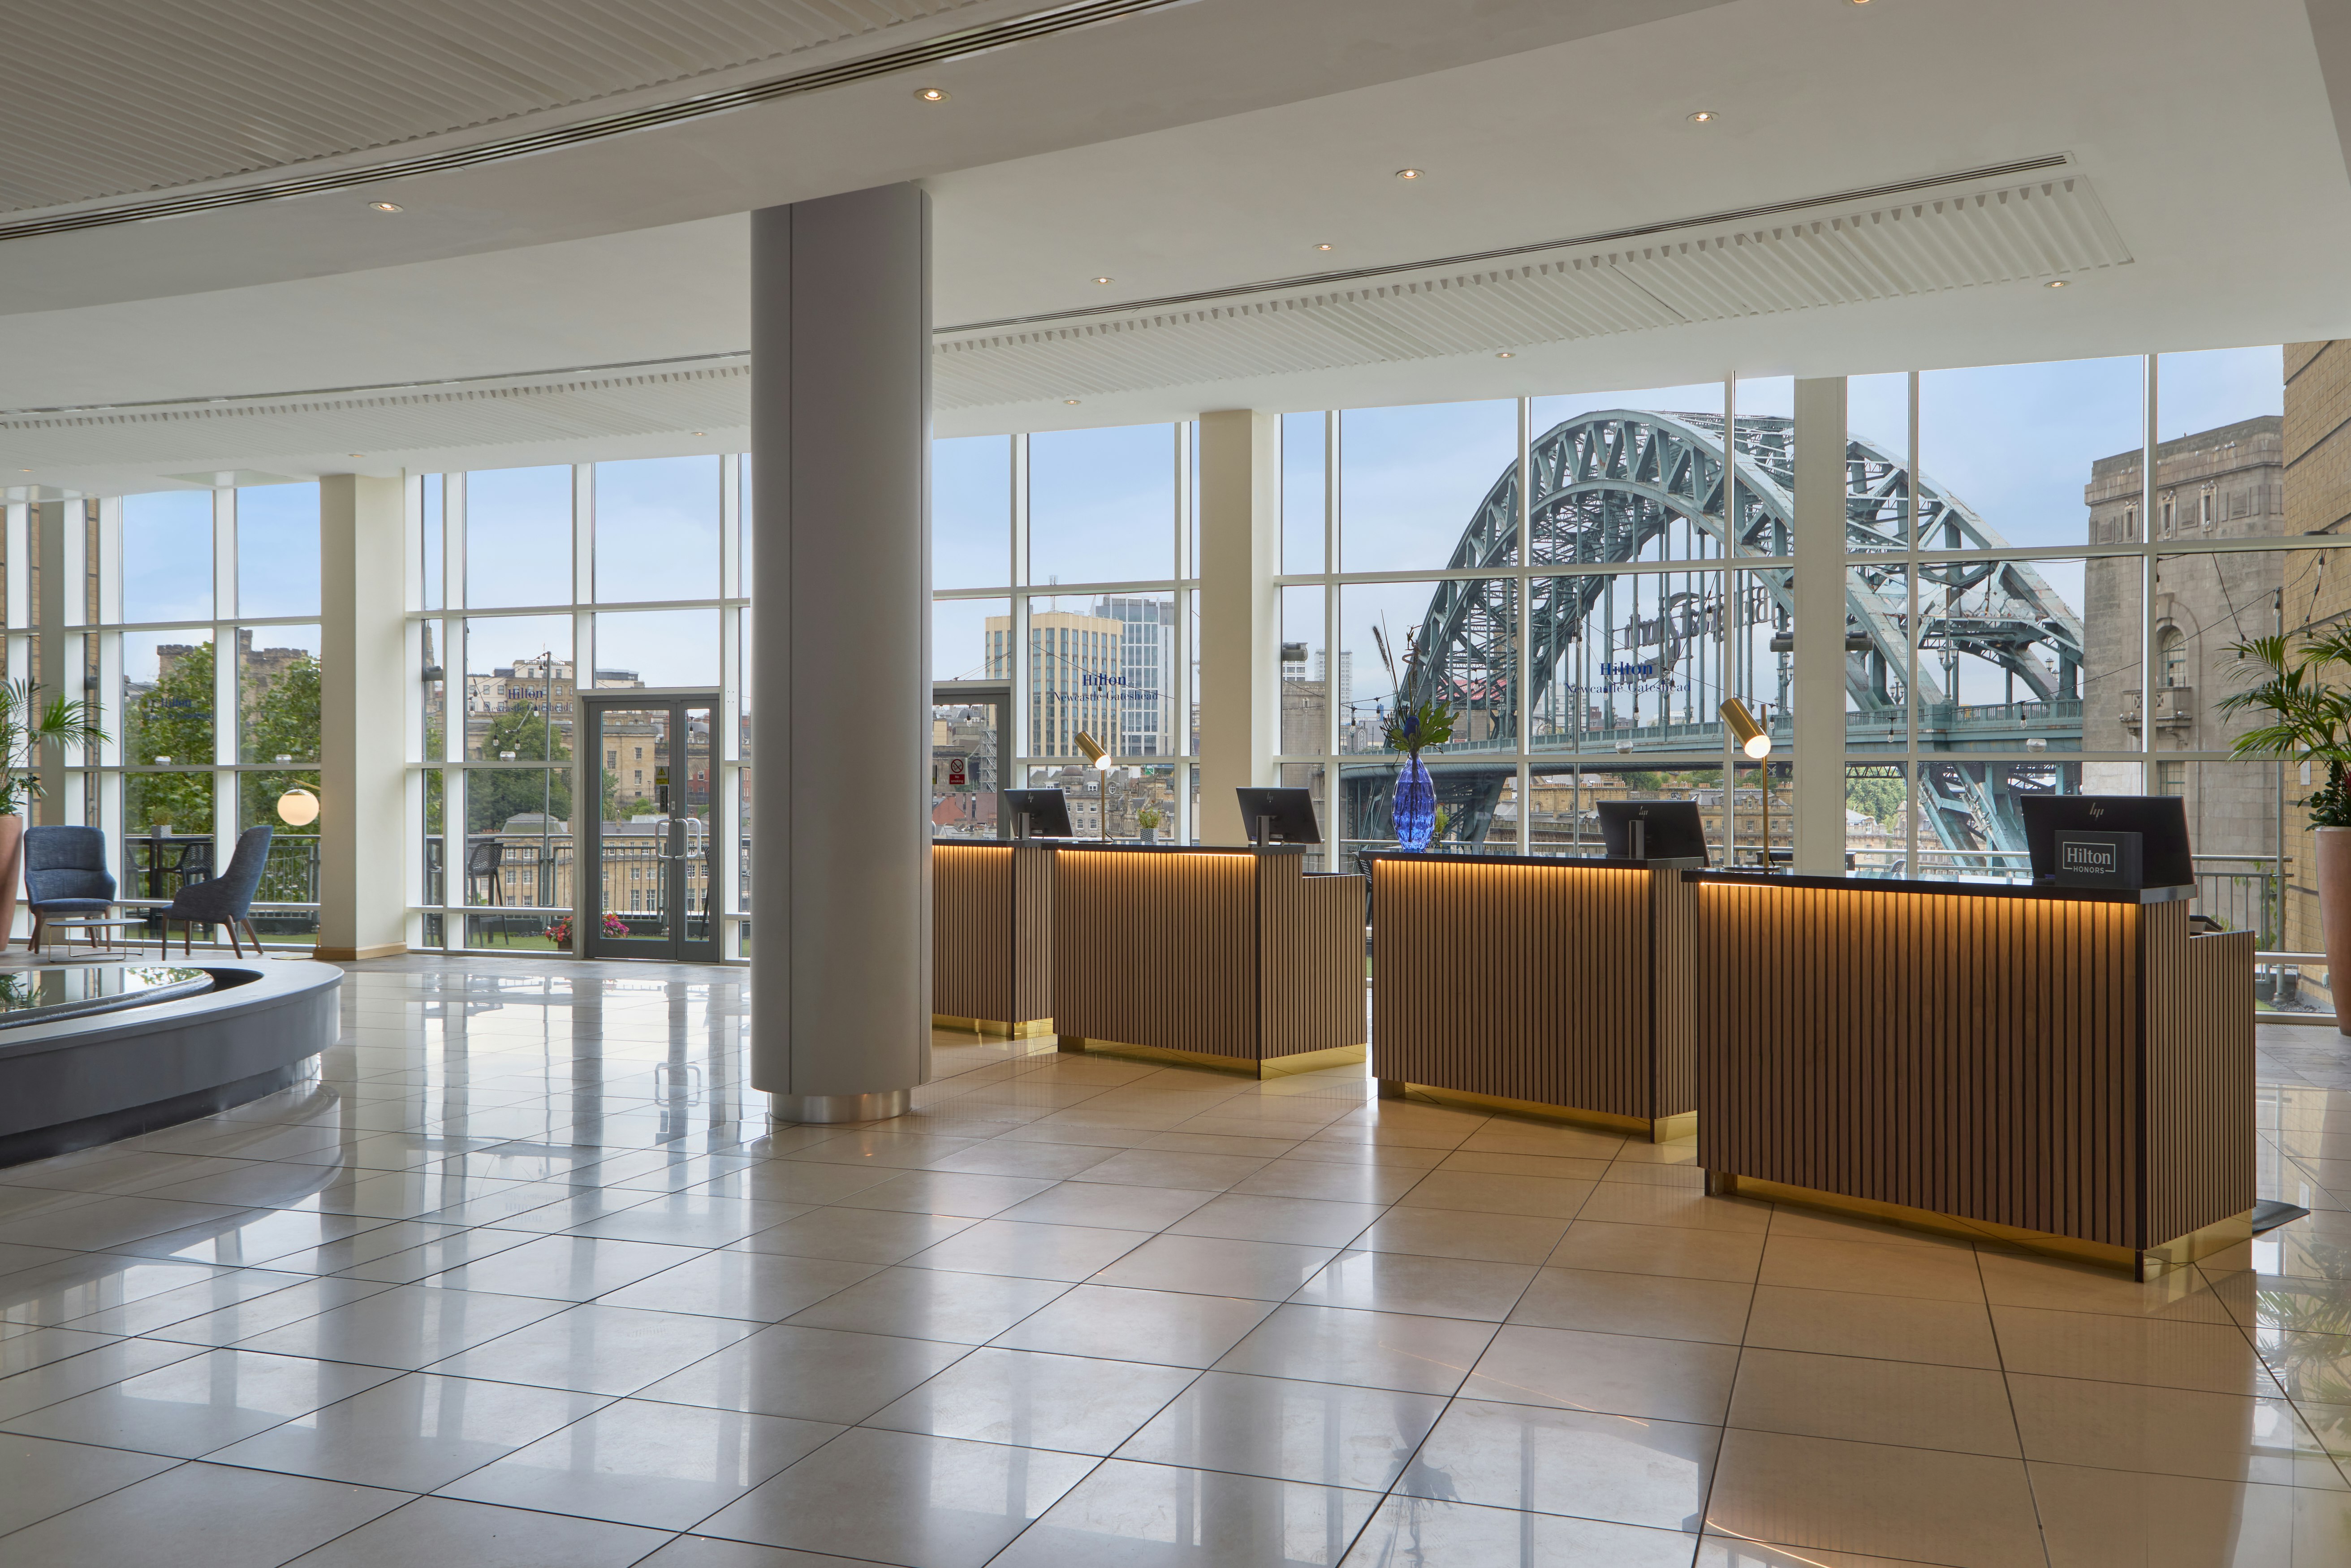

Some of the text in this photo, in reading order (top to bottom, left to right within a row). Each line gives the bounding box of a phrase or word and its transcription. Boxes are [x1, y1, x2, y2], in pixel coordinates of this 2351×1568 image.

[1600, 661, 1653, 675] Hilton
[1083, 673, 1126, 686] Hilton
[508, 688, 543, 699] Hilton
[1054, 690, 1158, 702] Newcastle Gateshead
[2090, 802, 2104, 821] hp
[2067, 847, 2111, 864] Hilton
